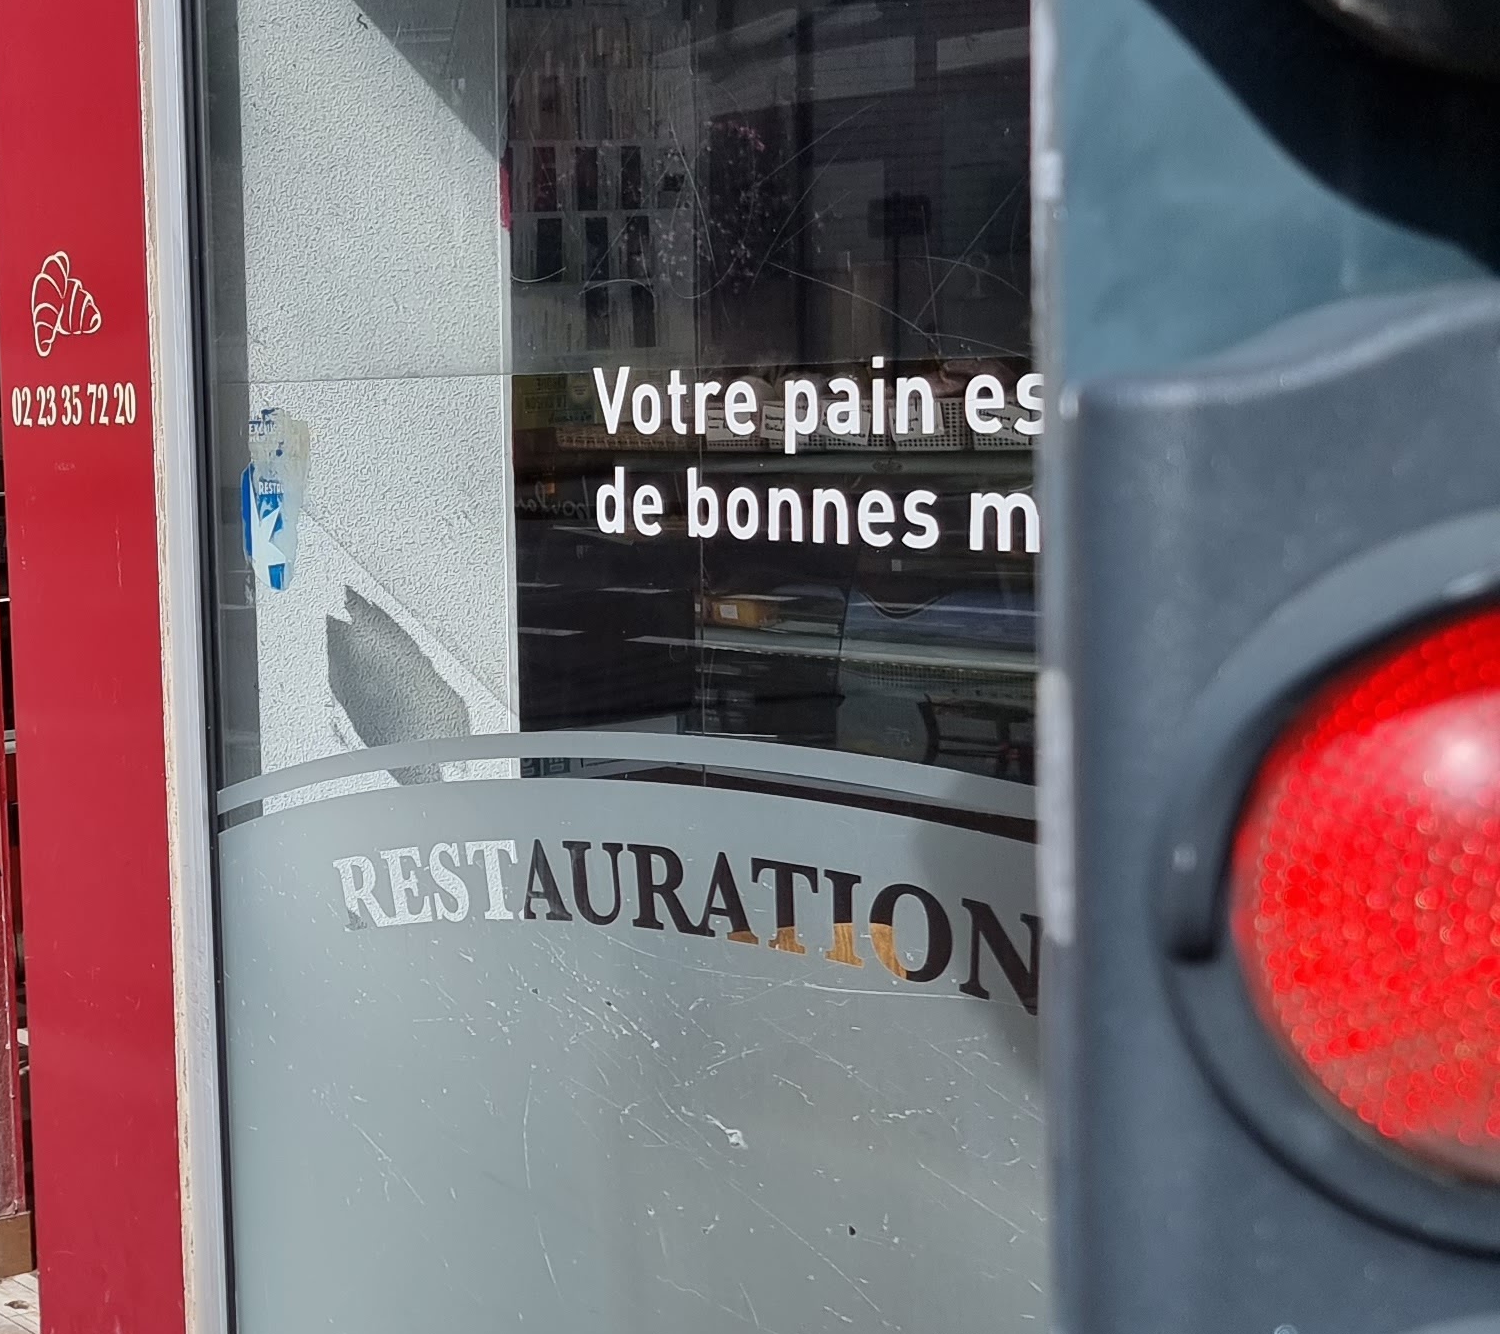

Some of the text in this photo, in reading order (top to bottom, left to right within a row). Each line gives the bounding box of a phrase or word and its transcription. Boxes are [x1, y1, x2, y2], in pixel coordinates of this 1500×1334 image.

[12, 382, 136, 427] 02 23 35 72 20
[592, 365, 758, 436] Votre
[782, 356, 936, 455] pain
[595, 468, 663, 537] de
[686, 468, 940, 550] bonnes
[332, 839, 1043, 1016] RESTAURATION
